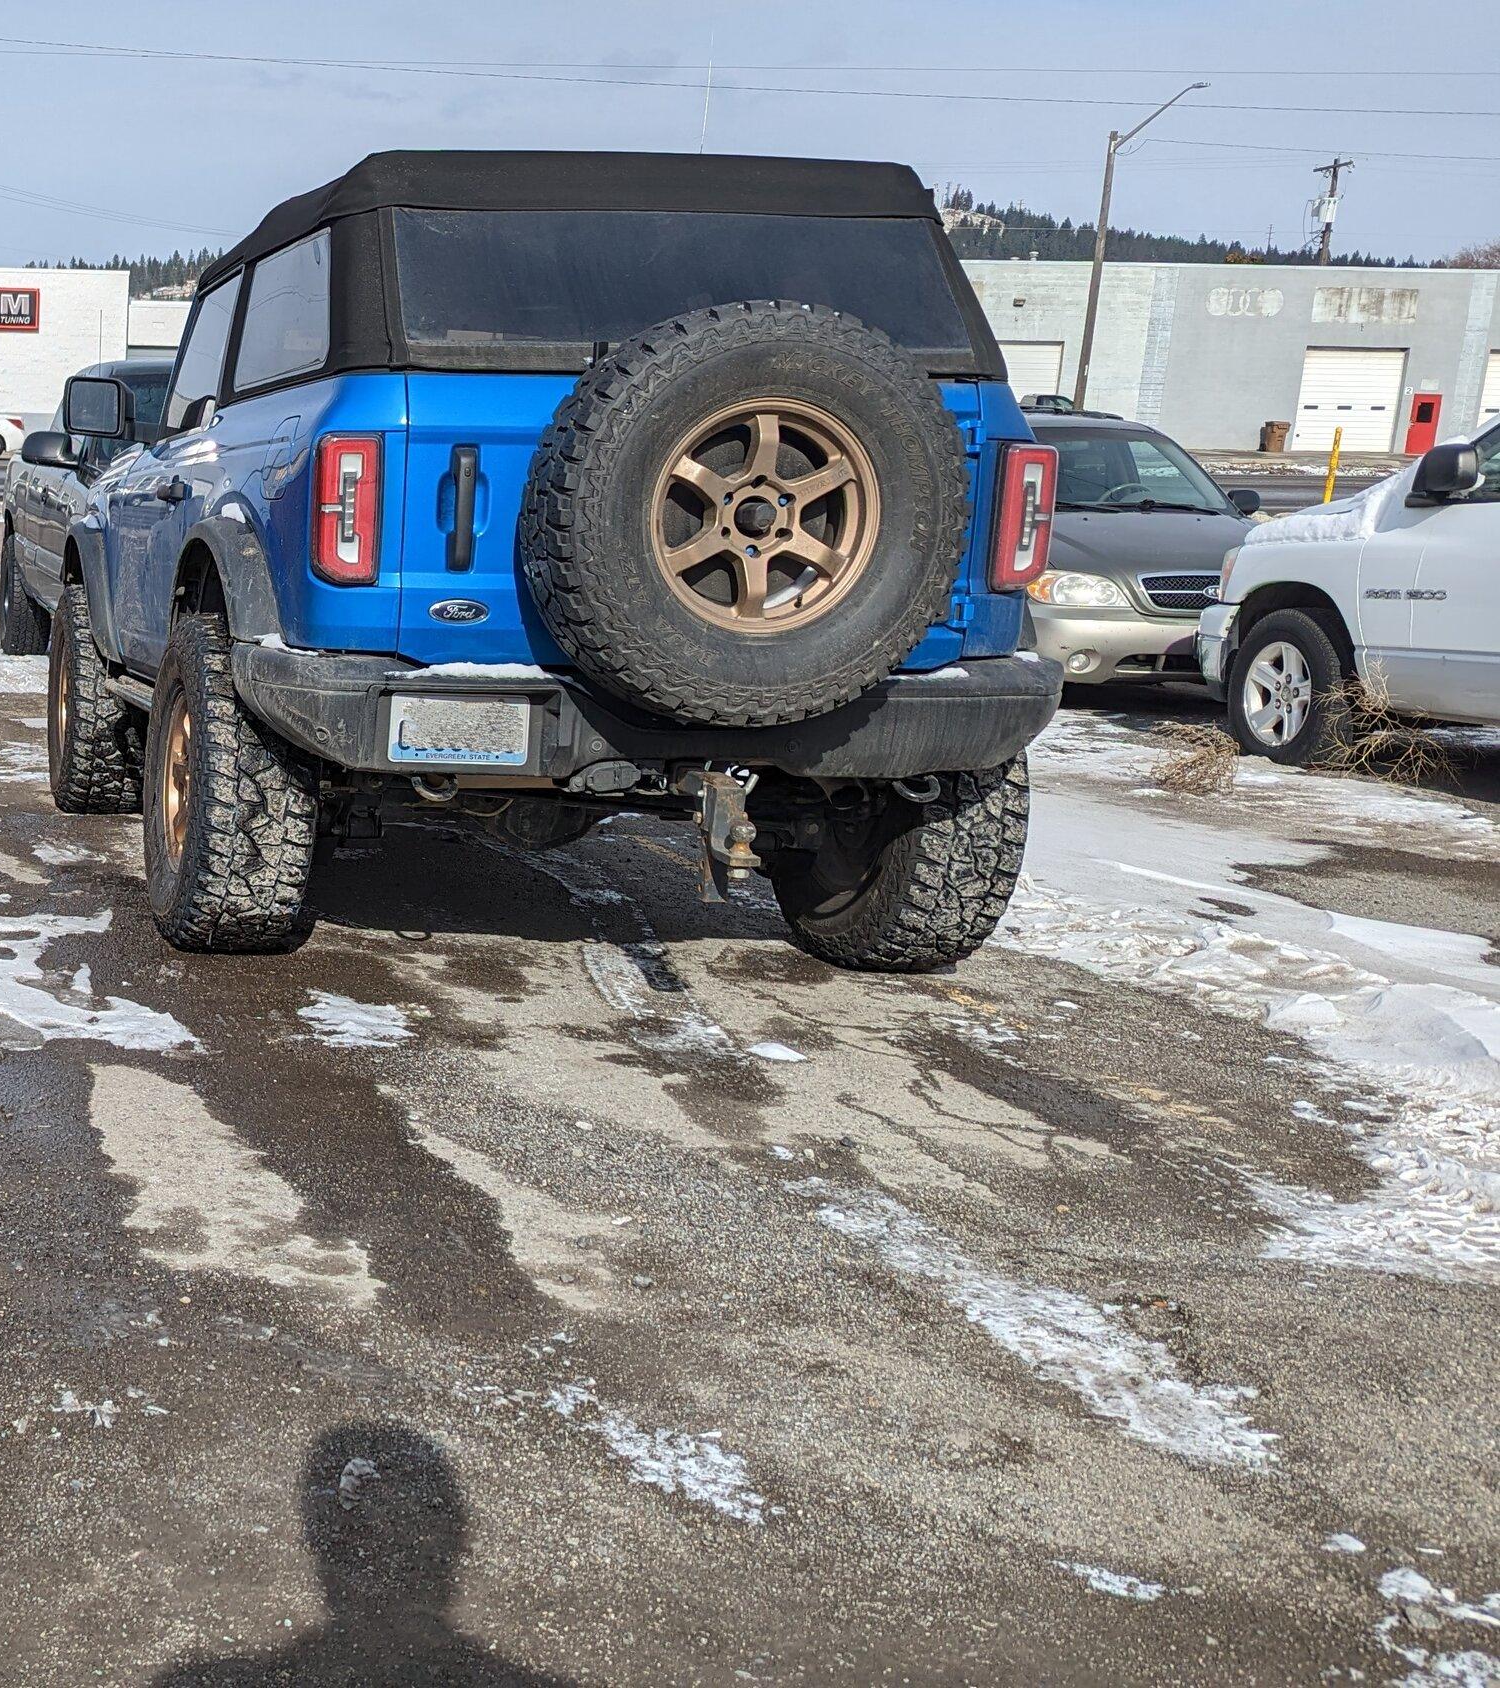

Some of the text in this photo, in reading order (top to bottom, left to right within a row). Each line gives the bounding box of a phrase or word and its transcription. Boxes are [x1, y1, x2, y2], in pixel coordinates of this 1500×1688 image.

[0, 315, 31, 324] TUNING
[771, 351, 882, 396] MICKEY
[880, 402, 934, 554] THOMPSON
[443, 604, 476, 619] Ford
[425, 752, 491, 761] EVERGREEN STATE
